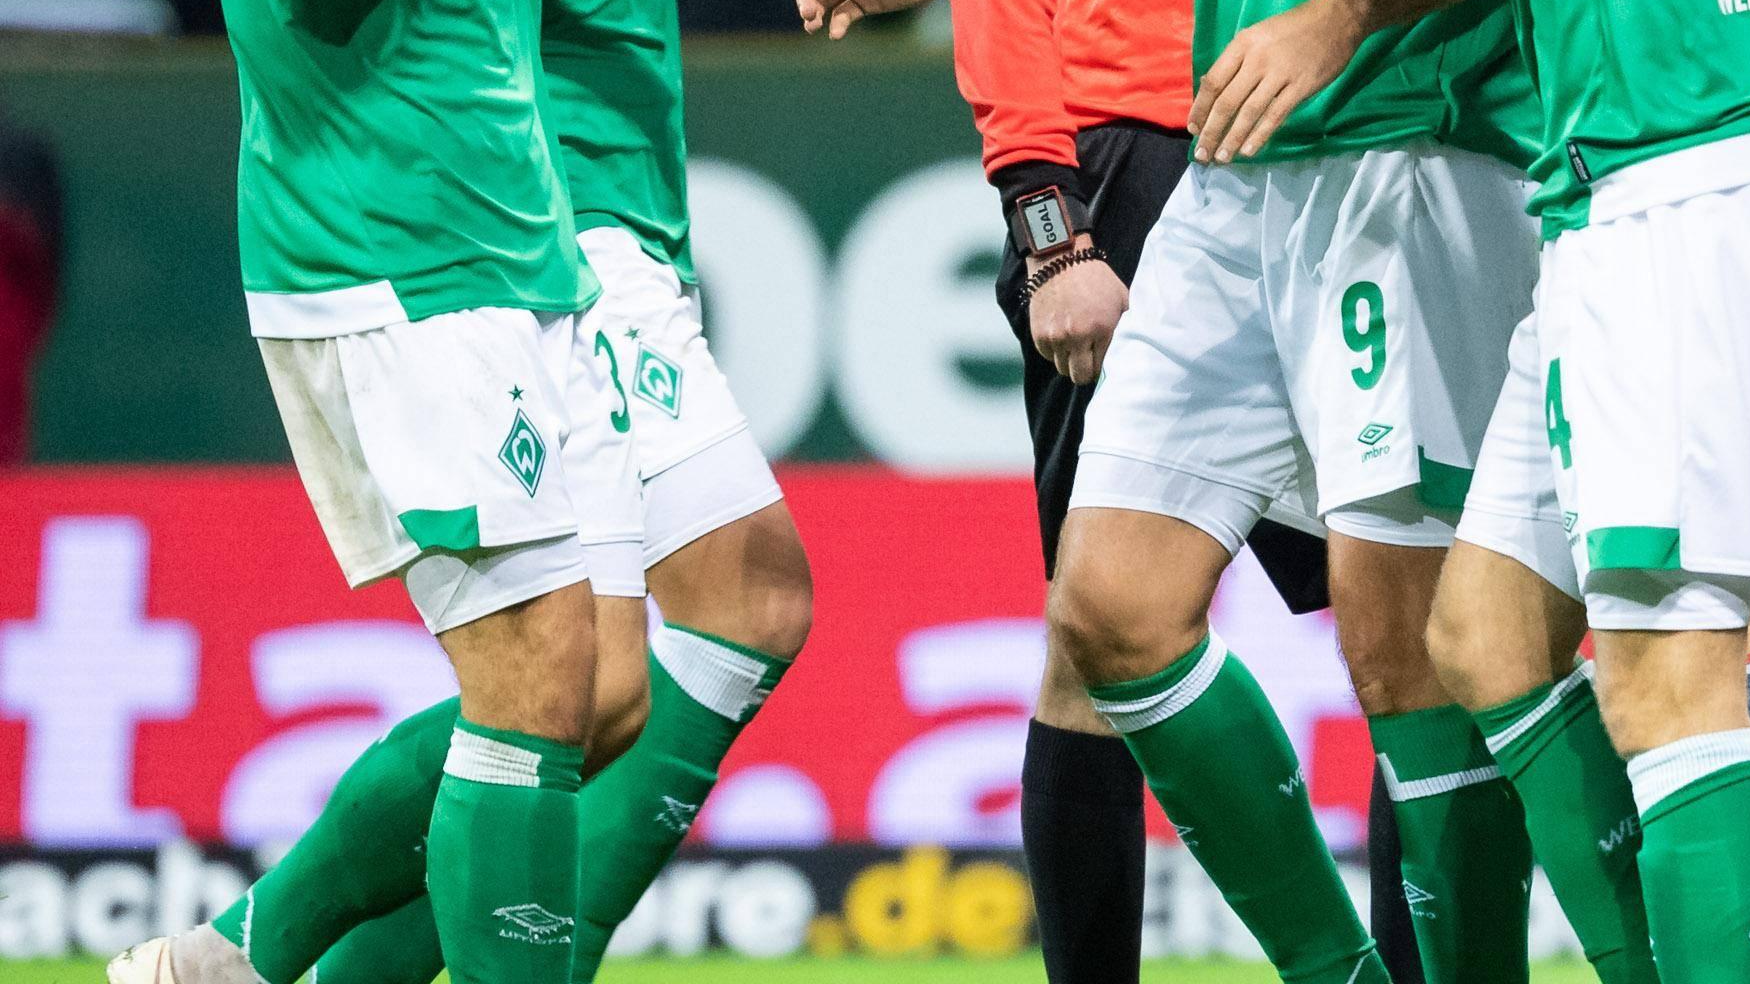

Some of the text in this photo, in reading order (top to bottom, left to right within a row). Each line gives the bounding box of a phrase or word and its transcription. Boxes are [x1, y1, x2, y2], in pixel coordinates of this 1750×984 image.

[1038, 203, 1058, 244] GOAL
[1341, 281, 1386, 390] 9
[1546, 357, 1572, 470] 4
